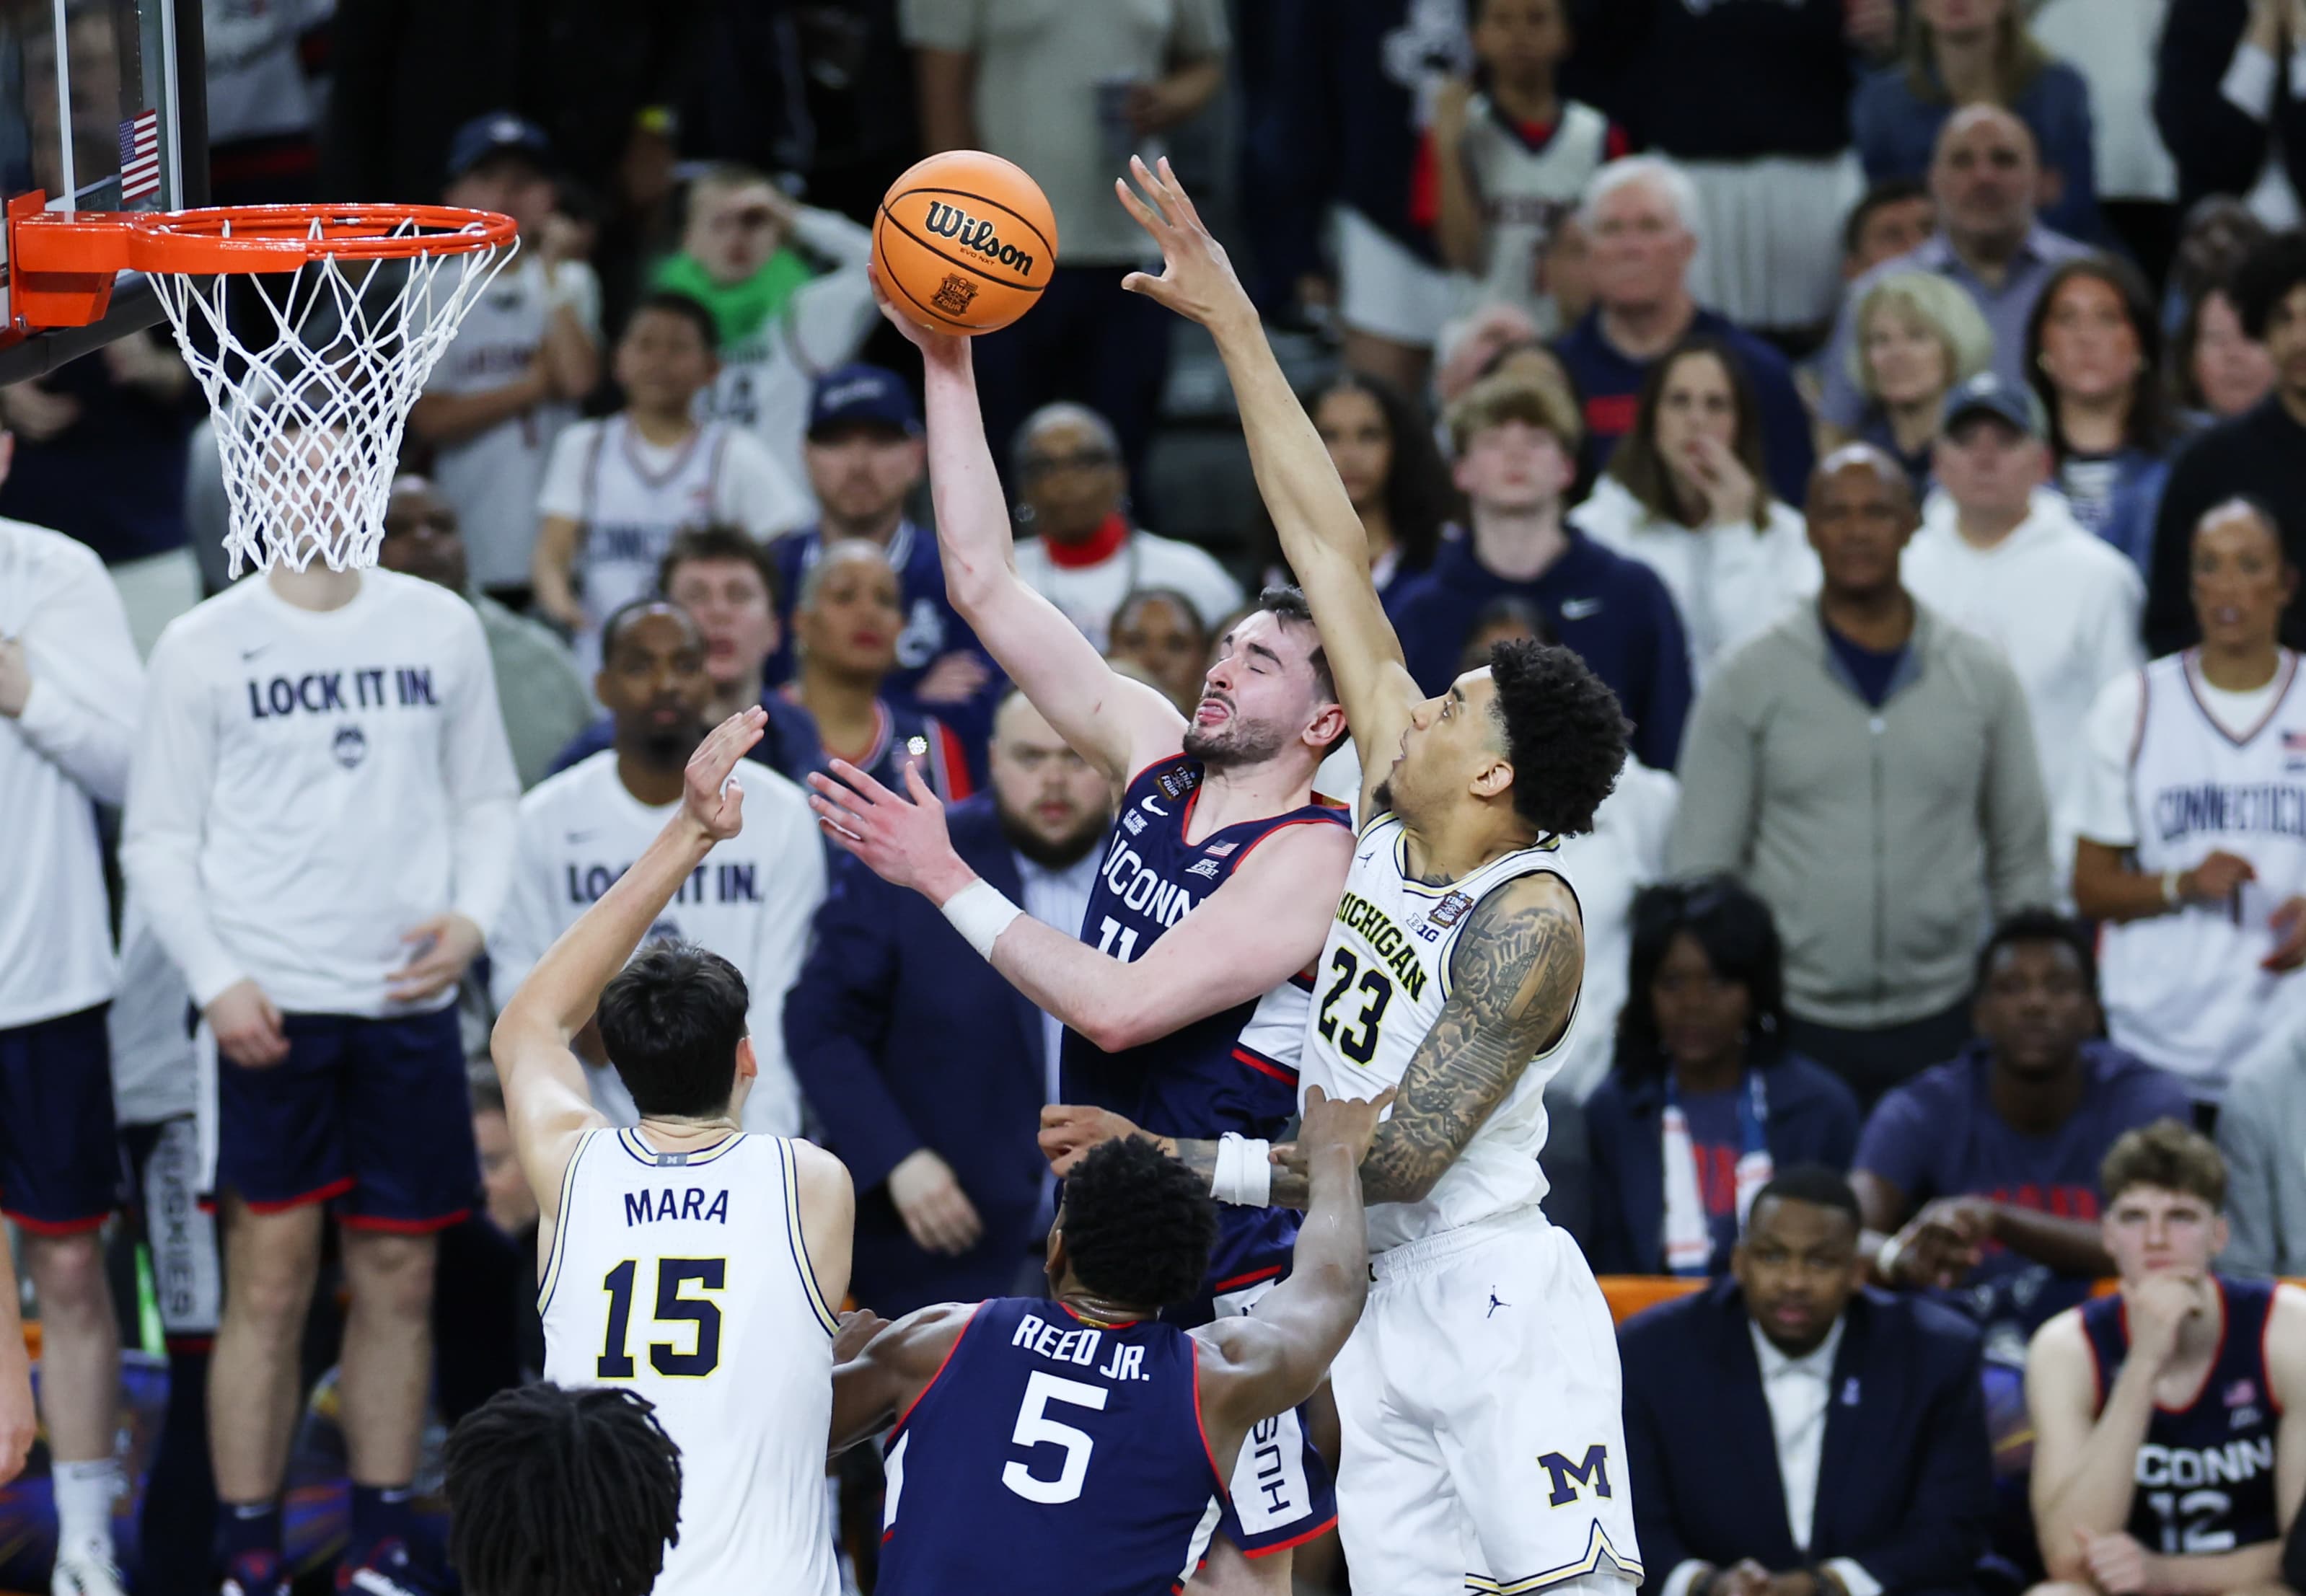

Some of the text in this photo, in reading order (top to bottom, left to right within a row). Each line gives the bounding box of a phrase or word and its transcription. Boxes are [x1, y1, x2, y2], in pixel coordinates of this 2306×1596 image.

[925, 200, 1034, 276] Wilson
[959, 247, 995, 267] EVO NXT
[937, 296, 962, 312] FOUR
[945, 281, 971, 299] FINAL
[247, 663, 440, 719] LOCK IT IN.
[1161, 775, 1180, 797] FOUR
[1176, 766, 1194, 790] FINAL
[1132, 813, 1148, 829] THE
[567, 861, 633, 904] LO
[718, 861, 765, 904] IN.
[1190, 863, 1219, 877] EAST
[1198, 858, 1220, 868] BIG
[1434, 909, 1455, 923] FOUR
[1098, 914, 1140, 964] 11
[1318, 945, 1393, 1068] 23
[623, 1187, 729, 1227] MARA
[596, 1254, 728, 1381] 15
[1011, 1313, 1150, 1382] REED JR.
[1001, 1370, 1109, 1504] 5
[1536, 1443, 1613, 1509] M
[2134, 1434, 2272, 1486] CONN
[2147, 1489, 2236, 1552] 12
